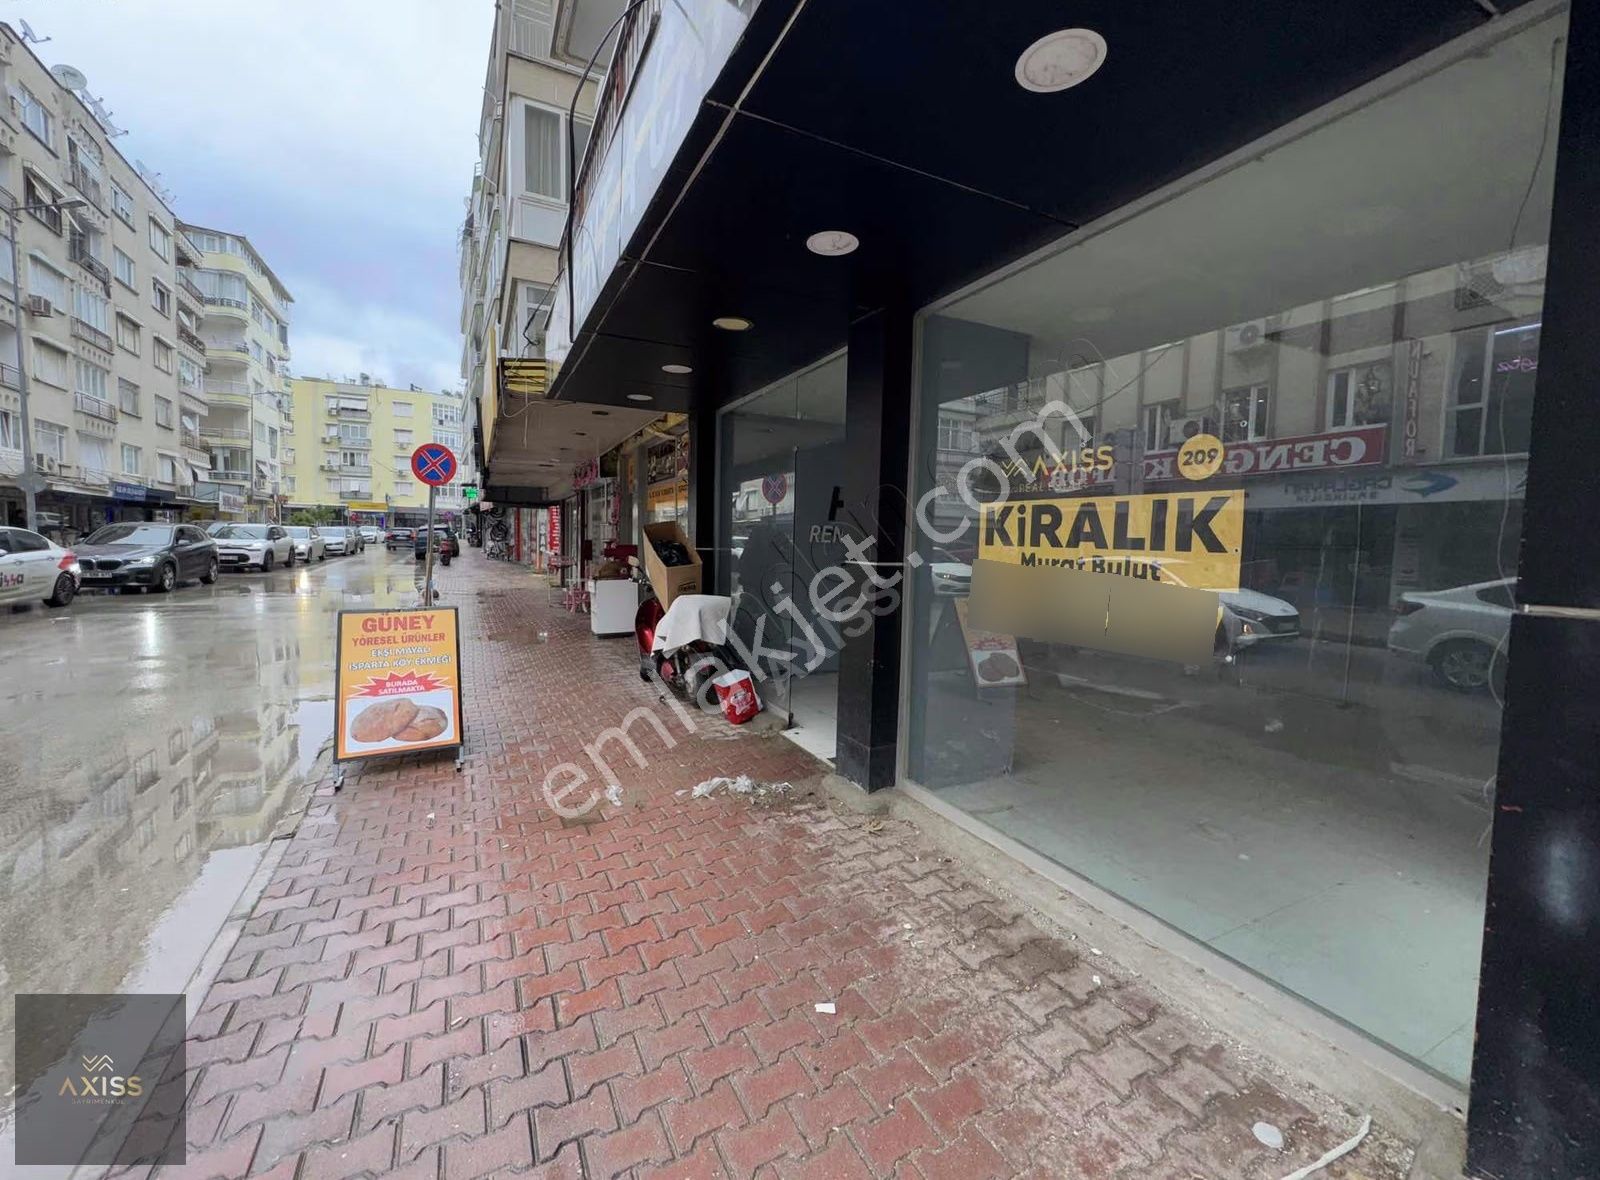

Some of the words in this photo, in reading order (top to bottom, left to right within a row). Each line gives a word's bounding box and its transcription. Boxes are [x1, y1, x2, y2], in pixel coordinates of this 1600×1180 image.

[1031, 445, 1114, 476] AXISS
[1182, 448, 1219, 466] 209
[1092, 555, 1161, 581] Bulut
[361, 613, 435, 633] GÜNEY
[352, 635, 401, 647] YÖRESEL
[401, 632, 446, 644] ÜRÜNLER
[395, 646, 431, 656] MAYALI
[378, 685, 425, 695] SATILMAKTA
[385, 679, 418, 688] BURADA
